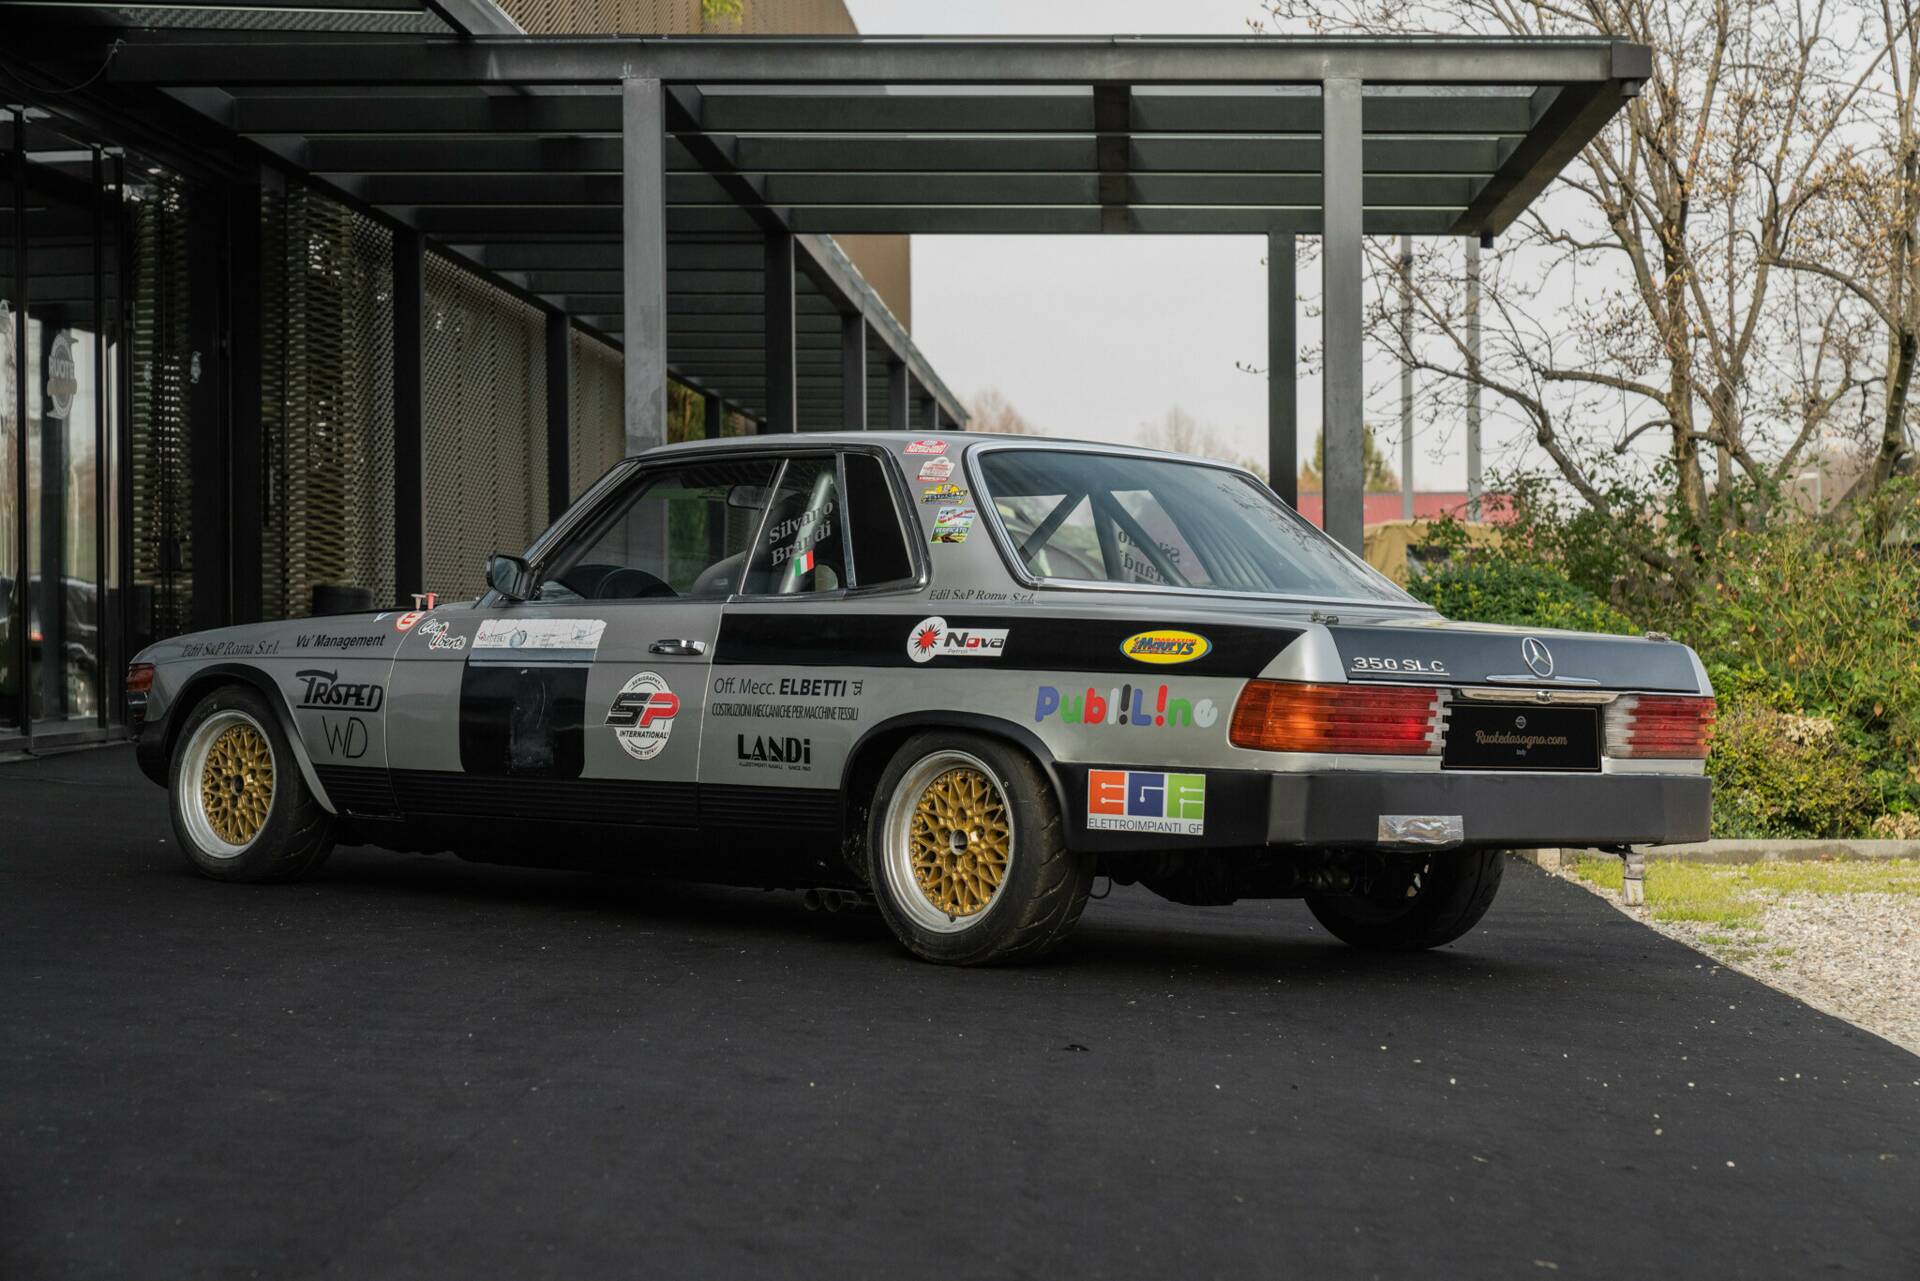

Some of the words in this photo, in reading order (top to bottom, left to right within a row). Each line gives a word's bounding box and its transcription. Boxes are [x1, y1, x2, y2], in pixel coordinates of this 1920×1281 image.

[771, 520, 831, 566] Brandi
[928, 588, 951, 600] Edil
[952, 588, 975, 600] S&P
[976, 590, 1007, 601] Roma
[224, 641, 254, 655] Roma
[314, 634, 386, 650] Management
[943, 631, 1005, 648] Nova
[1352, 656, 1398, 671] 350
[1402, 658, 1445, 672] SLC
[713, 677, 736, 694] Off.
[738, 678, 776, 695] Mecc.
[779, 678, 847, 697] ELBETTI
[604, 691, 681, 729] SP
[711, 702, 752, 717] COSTRUZIONI
[752, 703, 792, 719] MECCANICHE
[792, 705, 804, 719] PER
[804, 705, 837, 720] MACCHINE
[837, 706, 859, 721] TESSILI
[321, 715, 368, 758] WD
[619, 729, 668, 739] INTERNATIONAL
[1474, 730, 1568, 749] Ruotedasogno.com
[1088, 818, 1182, 833] ELETTROIMPIANTI
[1188, 823, 1203, 834] GF
